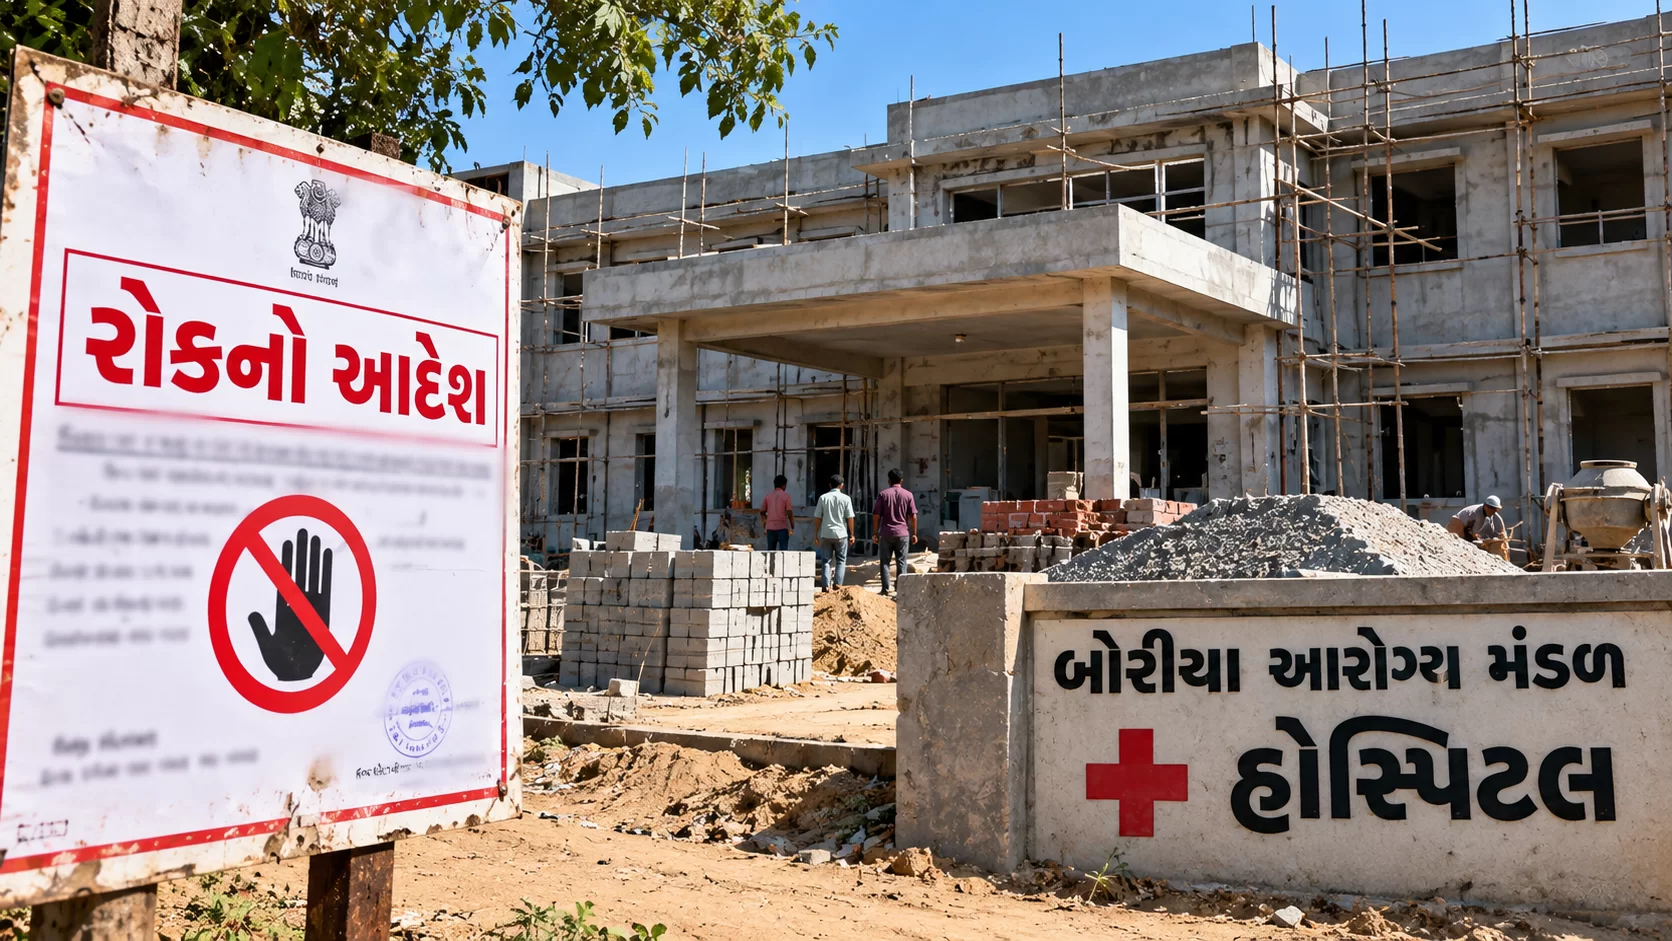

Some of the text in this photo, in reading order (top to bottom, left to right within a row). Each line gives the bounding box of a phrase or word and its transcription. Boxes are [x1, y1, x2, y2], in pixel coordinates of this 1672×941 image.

[85, 276, 487, 426] રોકનો આદેશ
[1053, 624, 1627, 695] બોરીયા આરોગ્ય મંડળ
[1230, 714, 1617, 834] હોસ્પિટલ
